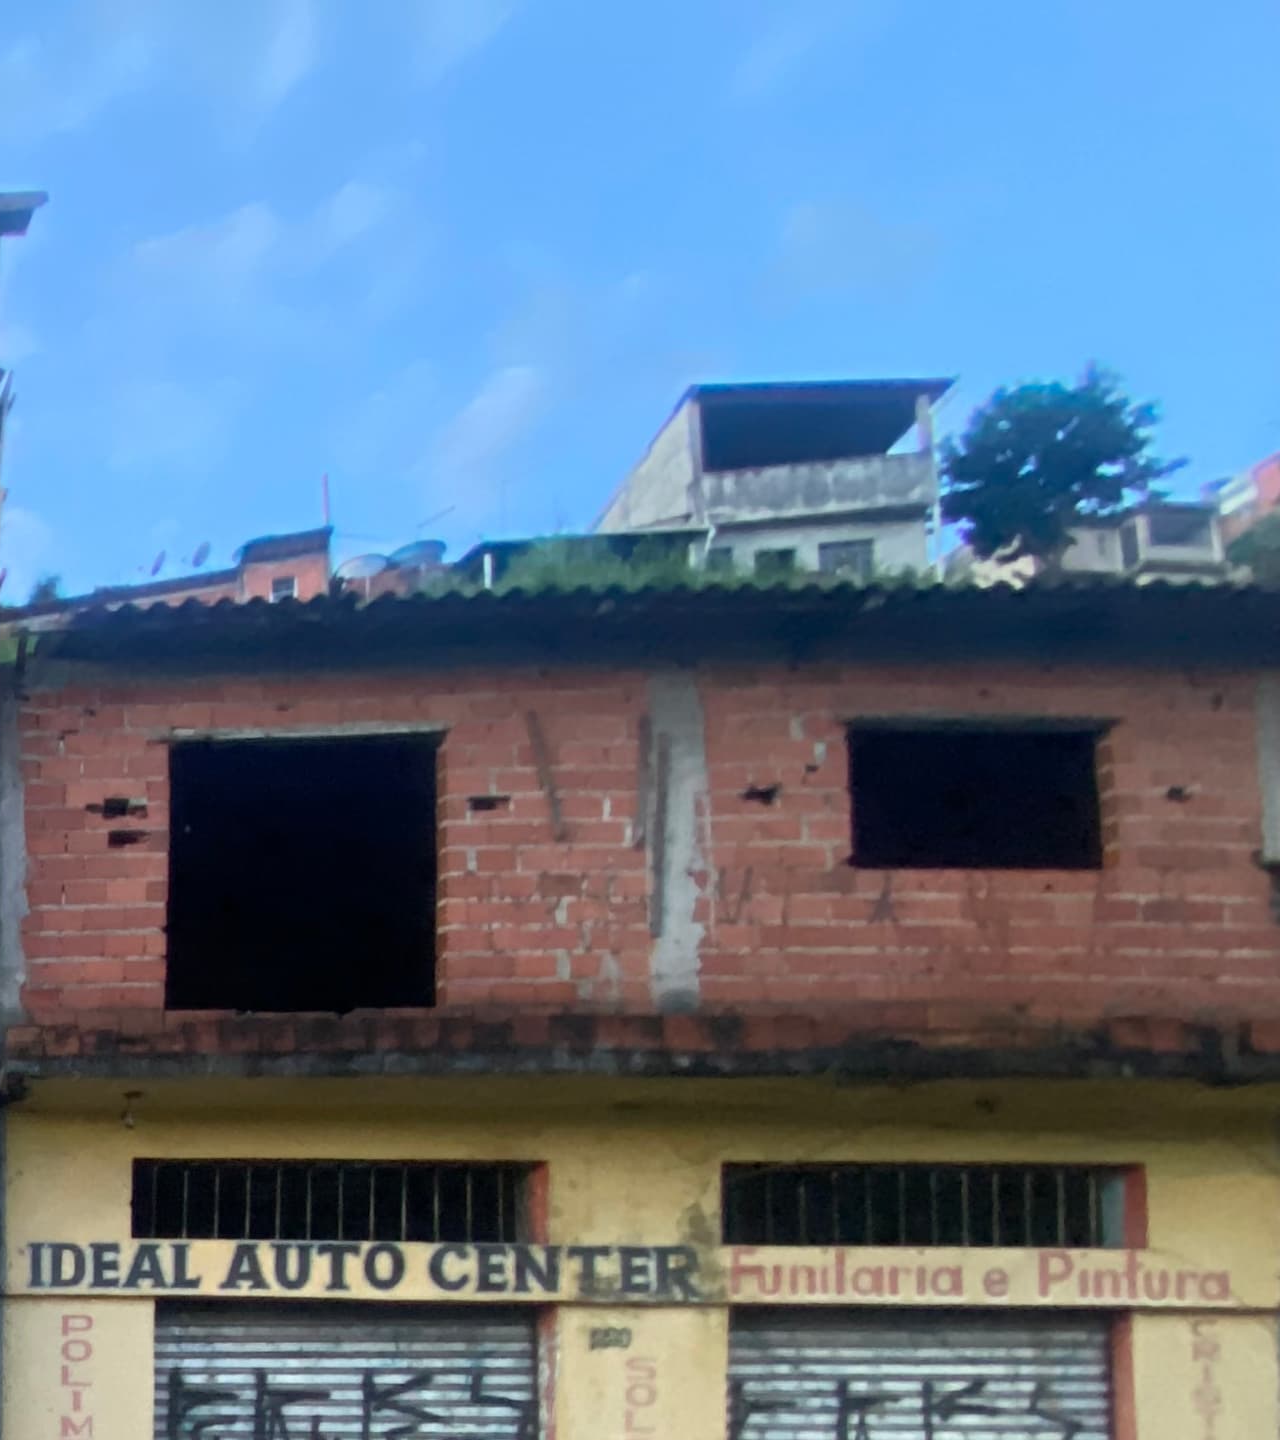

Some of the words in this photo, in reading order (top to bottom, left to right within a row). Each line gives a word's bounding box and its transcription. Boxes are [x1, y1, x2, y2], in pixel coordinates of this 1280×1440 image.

[27, 1241, 202, 1290] IDEAL
[217, 1242, 406, 1292] AUTO
[427, 1243, 700, 1299] CENTER
[728, 1247, 964, 1297] Funilaria
[983, 1267, 1010, 1297] e
[1038, 1249, 1231, 1301] Pintura
